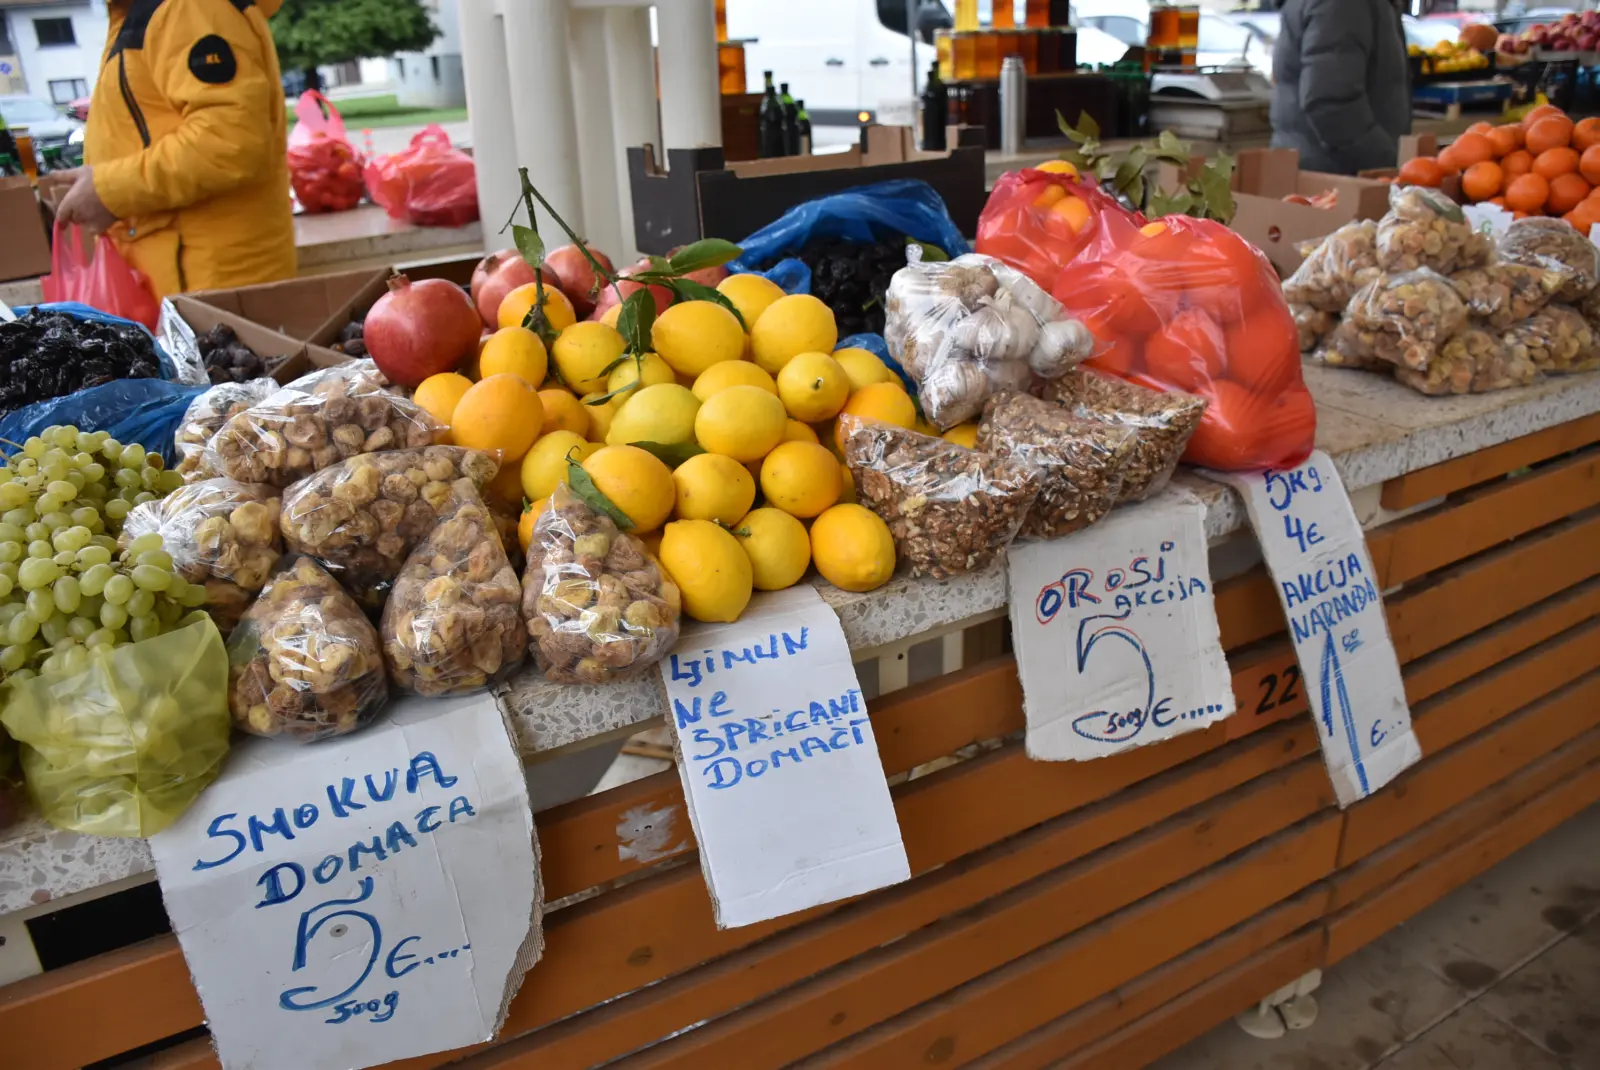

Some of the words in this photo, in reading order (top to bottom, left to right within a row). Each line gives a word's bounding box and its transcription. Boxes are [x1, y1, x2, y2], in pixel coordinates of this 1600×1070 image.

[1072, 608, 1155, 743] 5
[1255, 664, 1299, 715] 22
[192, 751, 459, 871] SMOKVA
[279, 876, 382, 1011] 5
